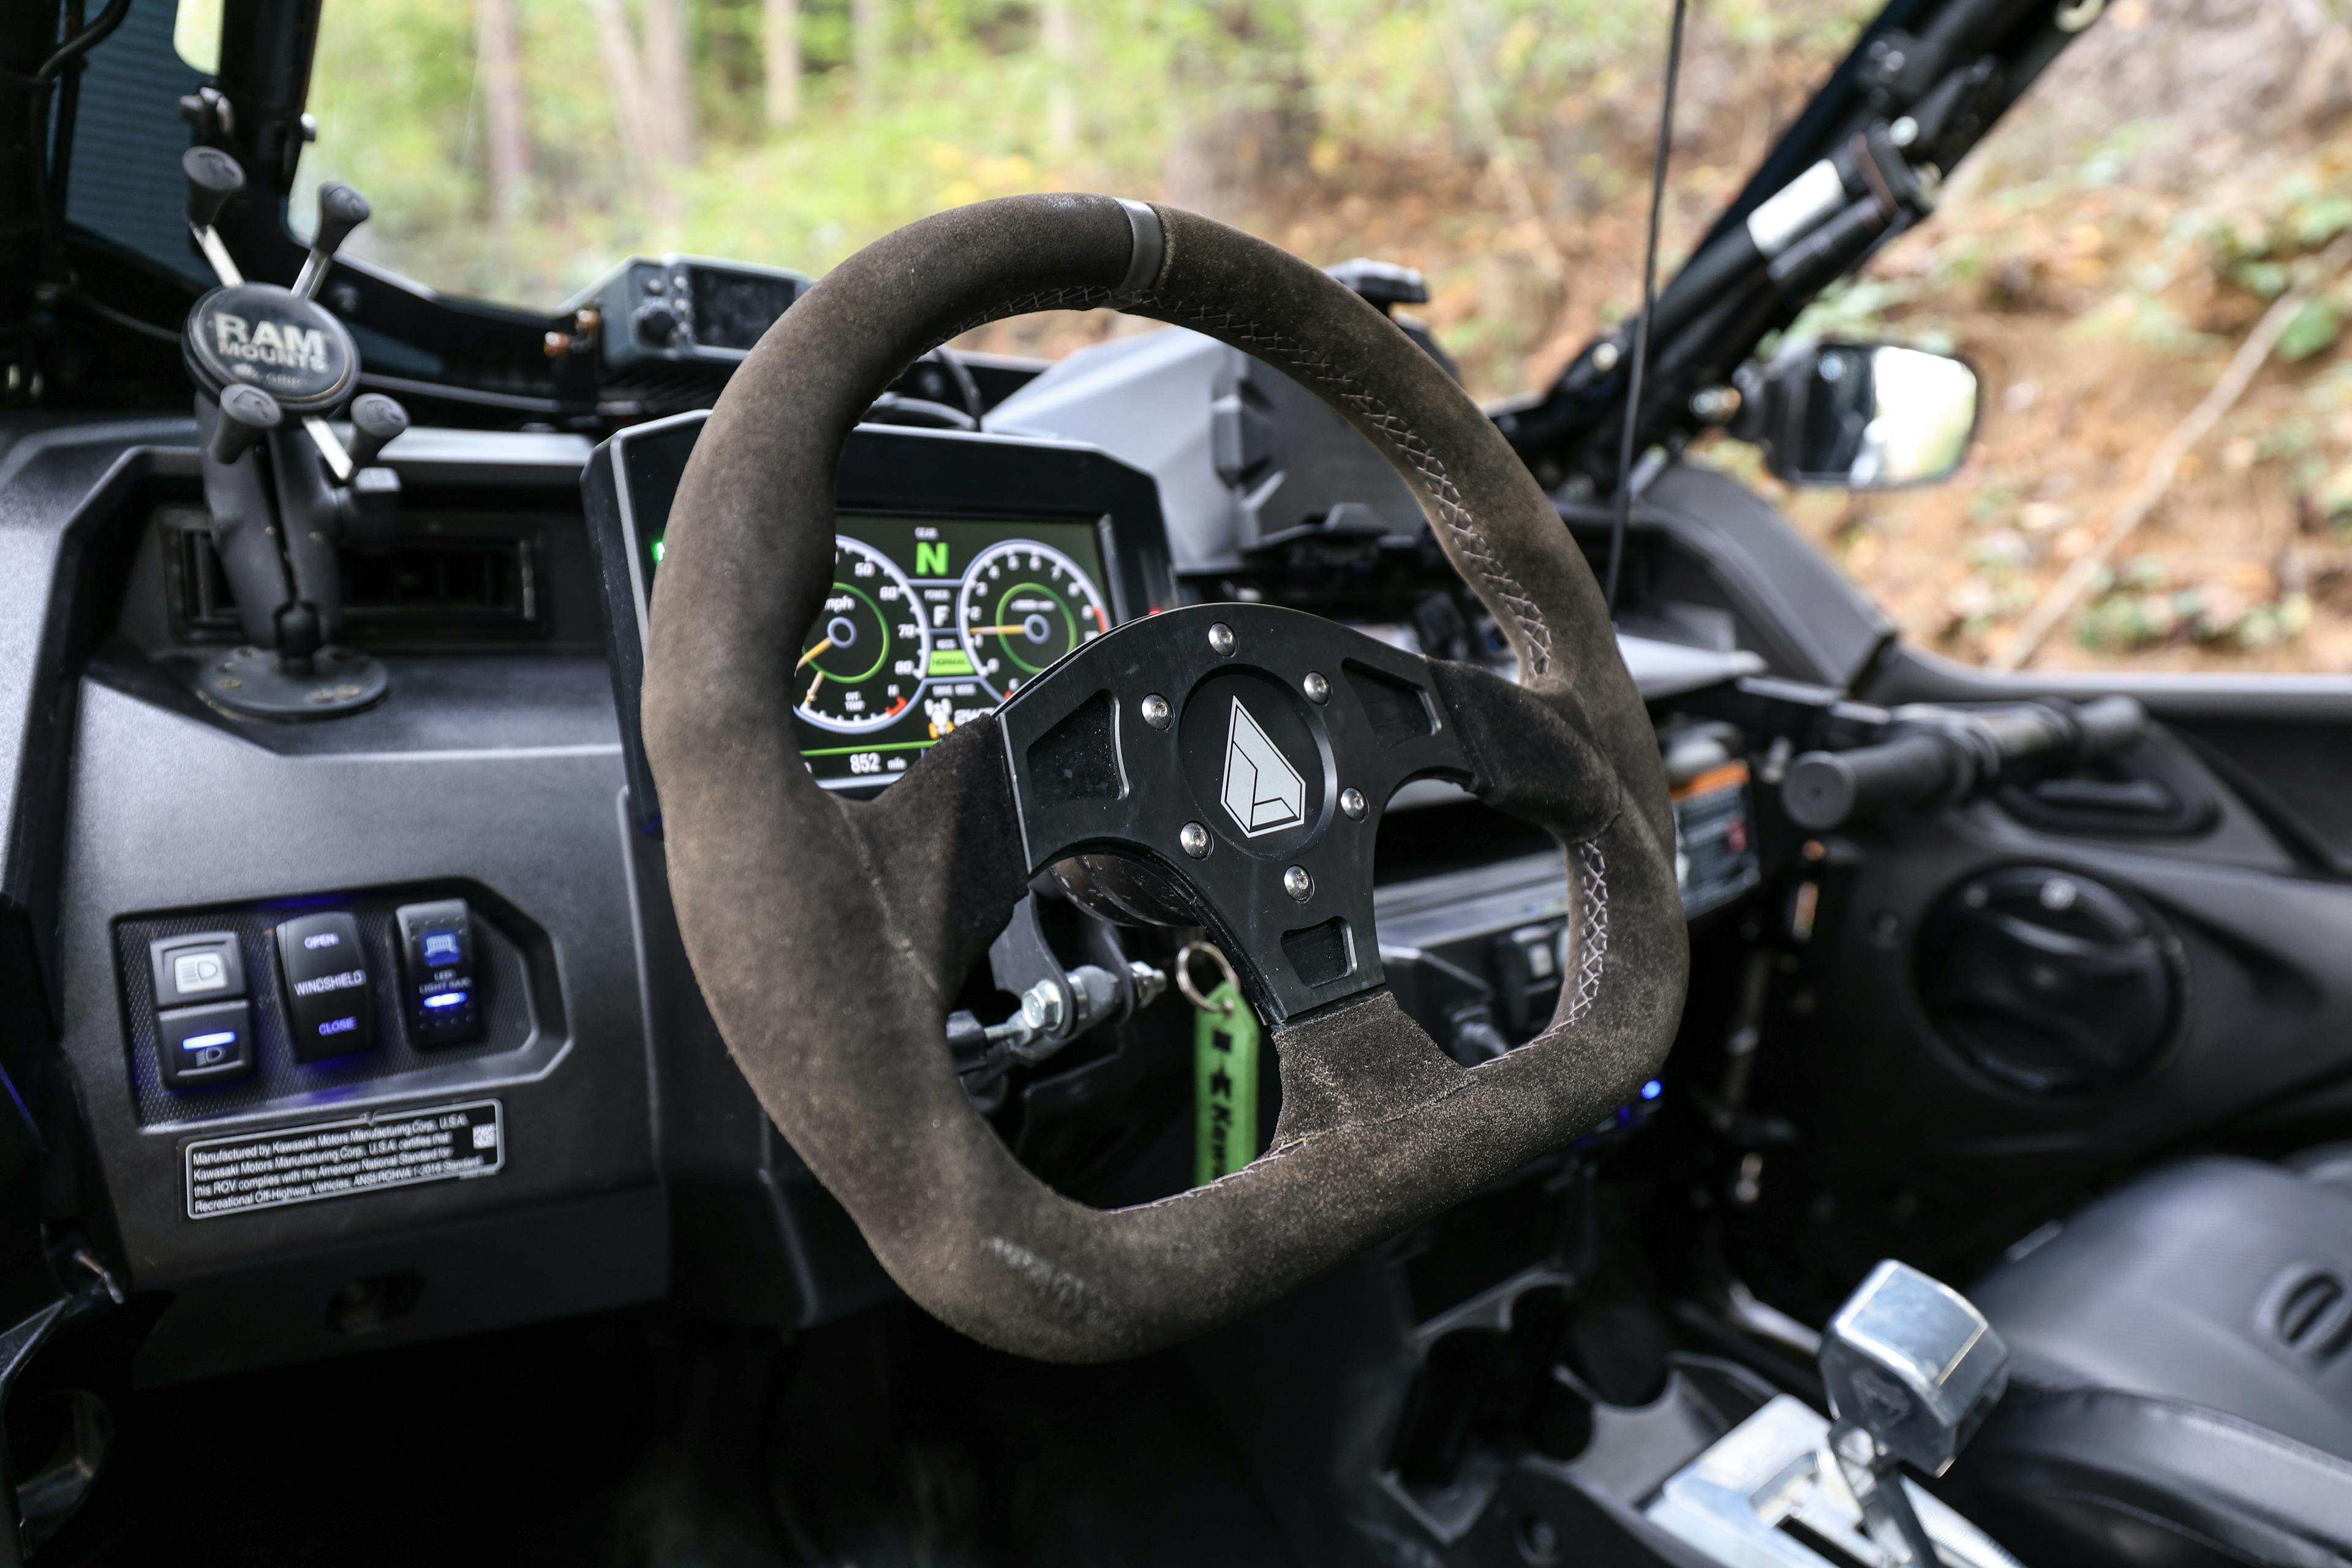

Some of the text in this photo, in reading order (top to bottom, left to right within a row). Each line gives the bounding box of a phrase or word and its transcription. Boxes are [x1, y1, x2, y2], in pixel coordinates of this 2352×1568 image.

[216, 313, 325, 355] RAM
[218, 341, 329, 373] MOUNTS
[916, 542, 949, 576] N
[854, 562, 875, 577] 50
[989, 565, 1000, 580] 4
[1050, 565, 1062, 580] 7
[880, 586, 899, 601] 60
[976, 582, 988, 597] 3
[933, 605, 950, 627] F
[970, 605, 982, 621] 2
[897, 624, 916, 638] 70
[895, 660, 914, 675] 80
[987, 658, 1000, 673] 0
[850, 752, 907, 774] 852 mile
[304, 932, 339, 949] OPEN
[294, 969, 366, 997] WINDSHIELD
[434, 969, 456, 981] LED
[420, 980, 448, 995] LIGHT
[318, 1016, 358, 1036] CLOSE
[193, 1146, 257, 1165] Manufactured
[259, 1145, 271, 1158] by
[273, 1136, 315, 1153] Kawasaki
[318, 1134, 349, 1147] Motors
[350, 1123, 412, 1142] Manufacturing
[194, 1163, 238, 1182] Kawasaki
[241, 1161, 272, 1175] Motors
[275, 1150, 339, 1168] Manufacturing
[398, 1135, 431, 1150] certifies
[431, 1131, 453, 1145] that
[194, 1146, 454, 1198] this ROV complies with the American National Standard for
[195, 1194, 253, 1213] Recreational
[255, 1185, 310, 1203] Off-Highway
[353, 1166, 412, 1186] ANSI/ROHVA
